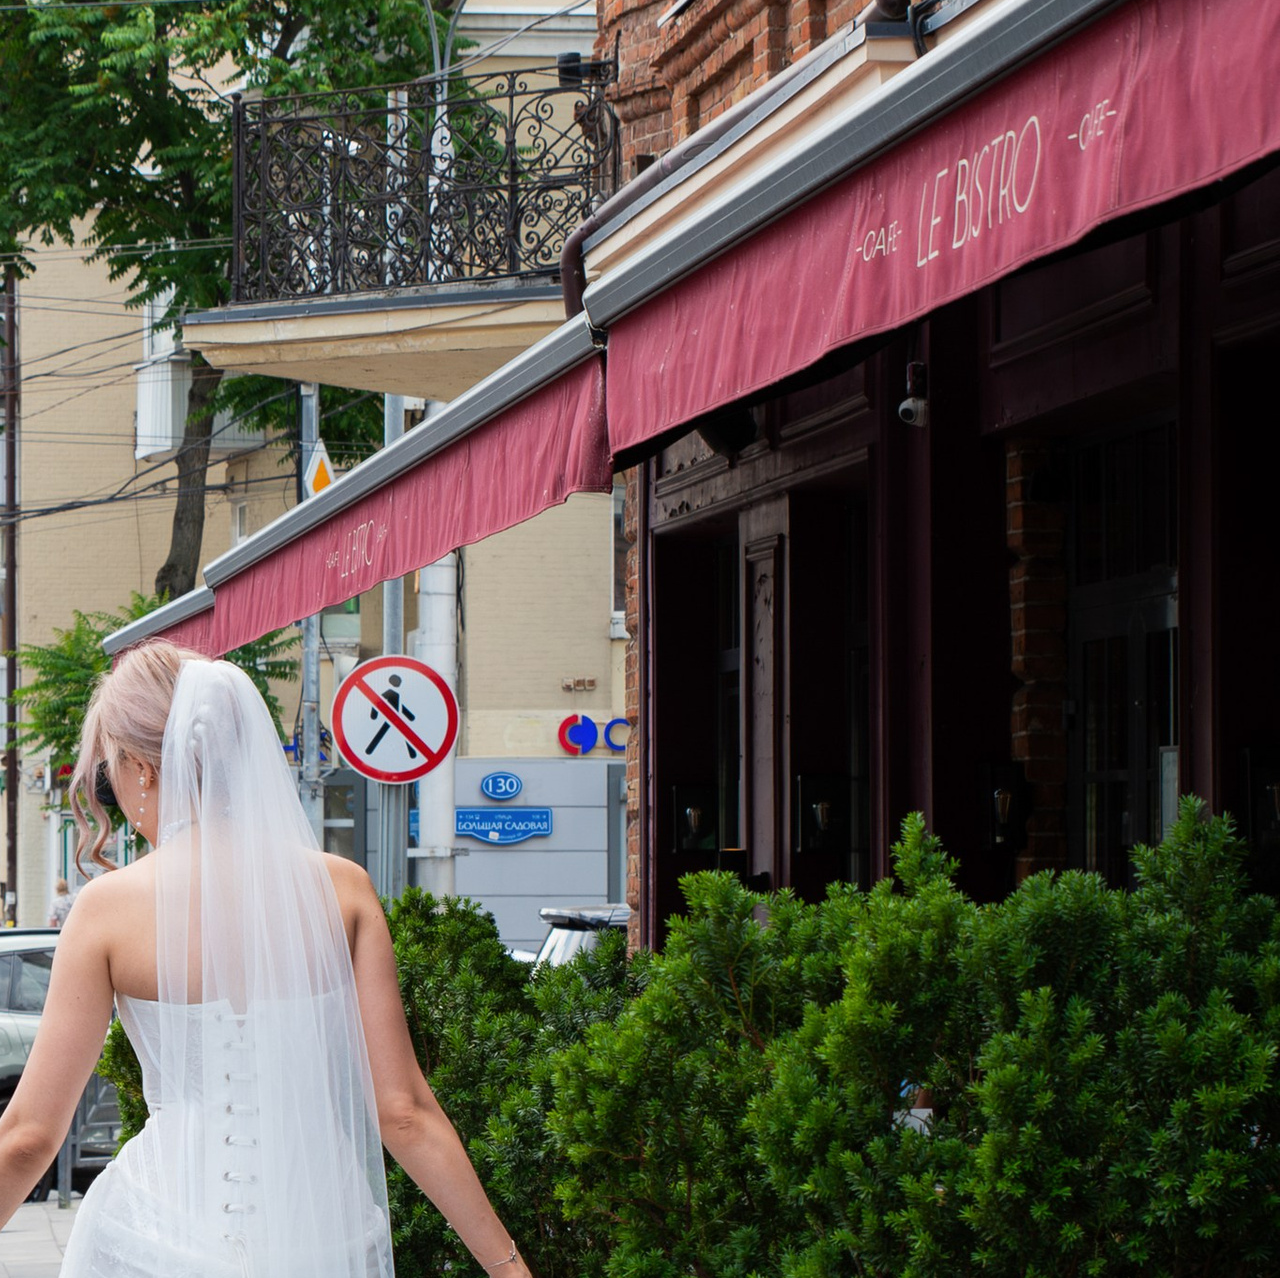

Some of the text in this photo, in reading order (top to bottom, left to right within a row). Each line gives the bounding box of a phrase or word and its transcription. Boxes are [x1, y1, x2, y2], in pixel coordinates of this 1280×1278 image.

[916, 168, 949, 267] LE
[952, 116, 1041, 250] BISTRO
[488, 778, 518, 793] 130
[458, 821, 548, 831] БОЛЬШАЯ САДОВАЯ
